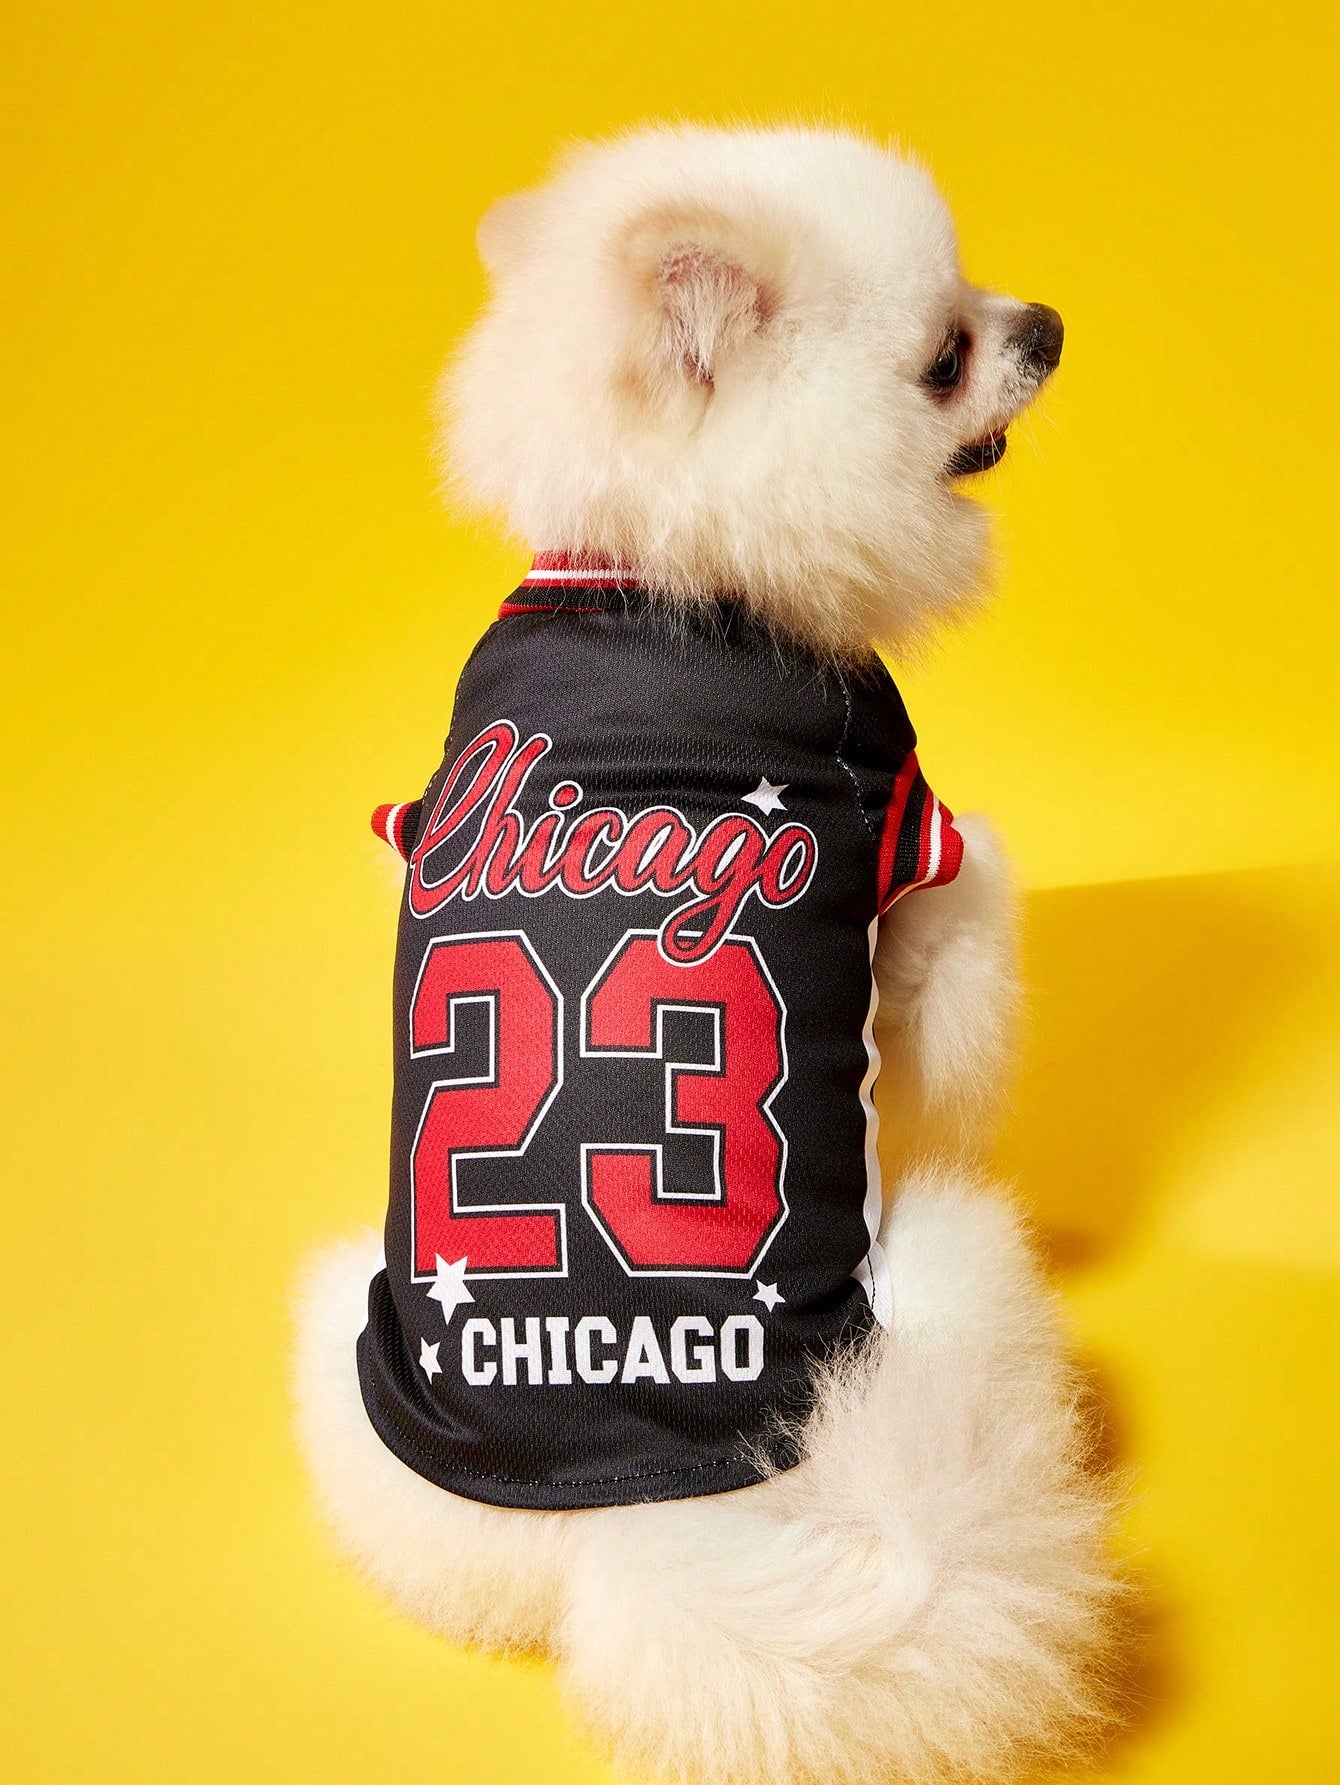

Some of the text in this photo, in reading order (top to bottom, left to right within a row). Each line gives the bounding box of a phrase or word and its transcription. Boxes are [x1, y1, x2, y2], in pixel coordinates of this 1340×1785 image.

[409, 718, 819, 967] Chicago
[409, 929, 789, 1284] 23
[460, 1314, 765, 1387] CHICAGO
